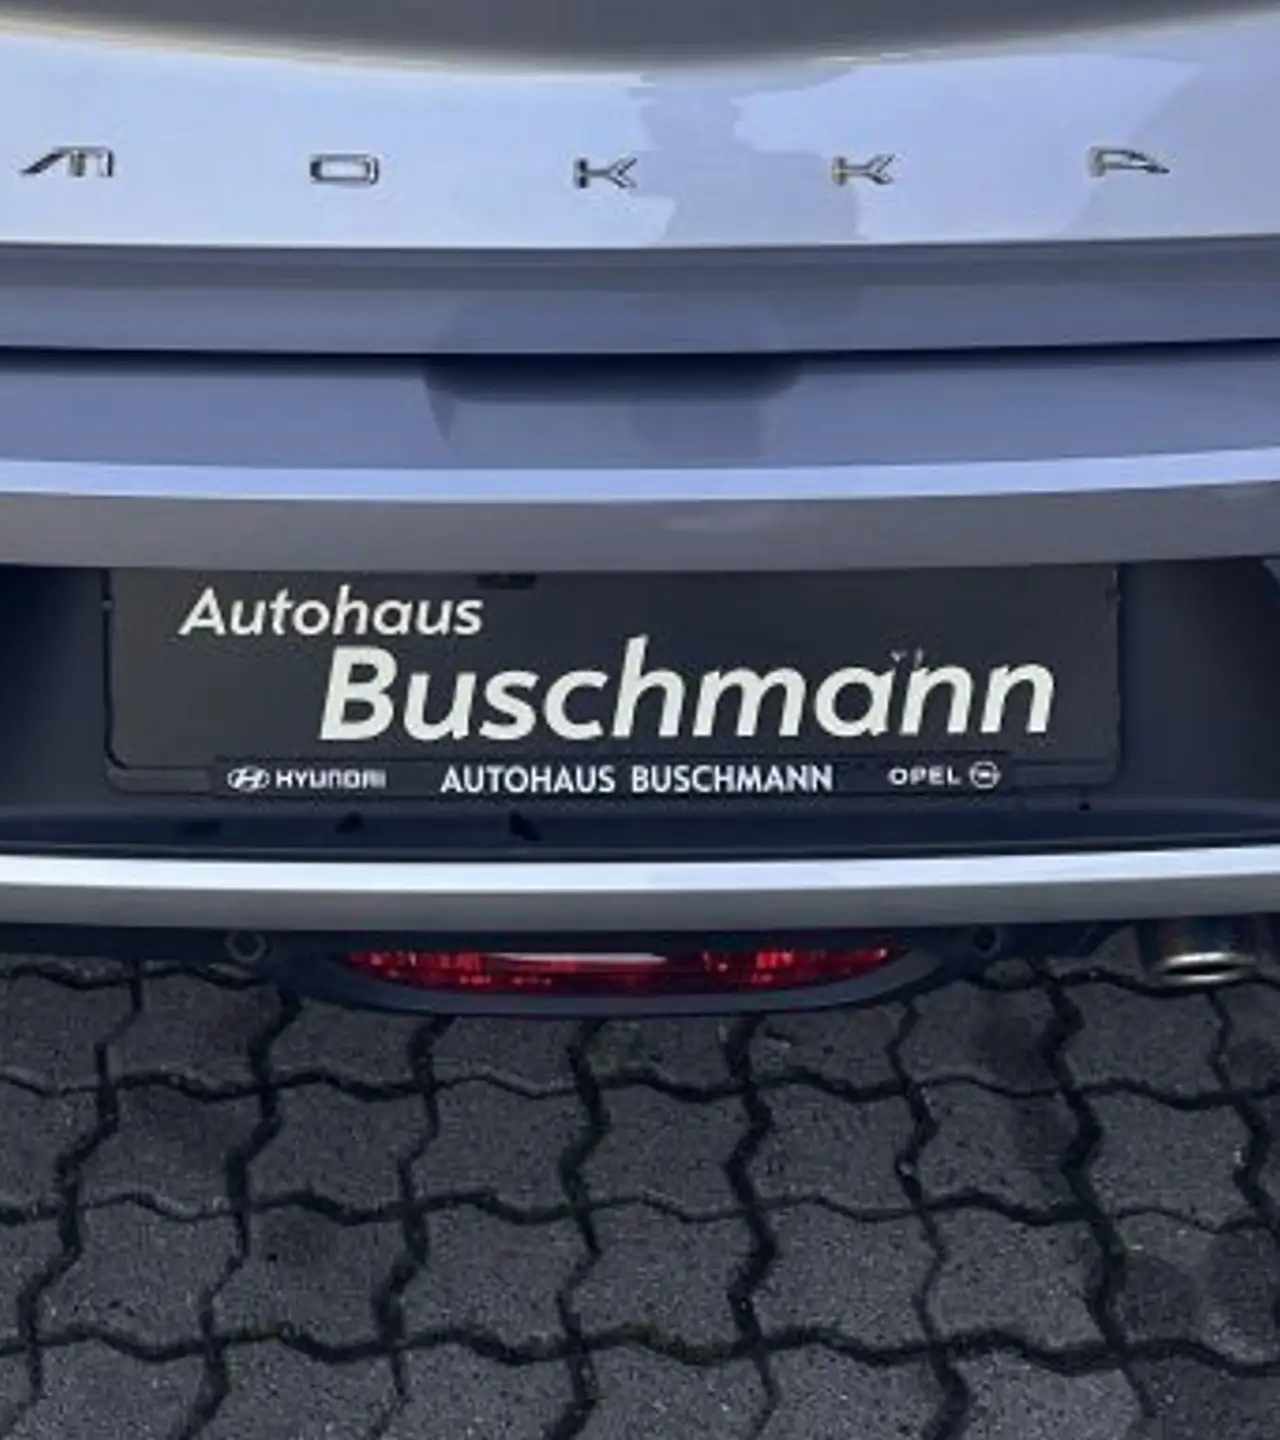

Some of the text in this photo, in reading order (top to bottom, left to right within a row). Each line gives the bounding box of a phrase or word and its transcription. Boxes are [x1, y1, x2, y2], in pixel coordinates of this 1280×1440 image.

[19, 146, 1170, 189] MOKKA
[177, 584, 484, 636] Autohaus
[318, 634, 1055, 742] Buschmann
[440, 764, 833, 794] AUTOHAUS BUSCHMANN
[887, 766, 962, 786] OPEL
